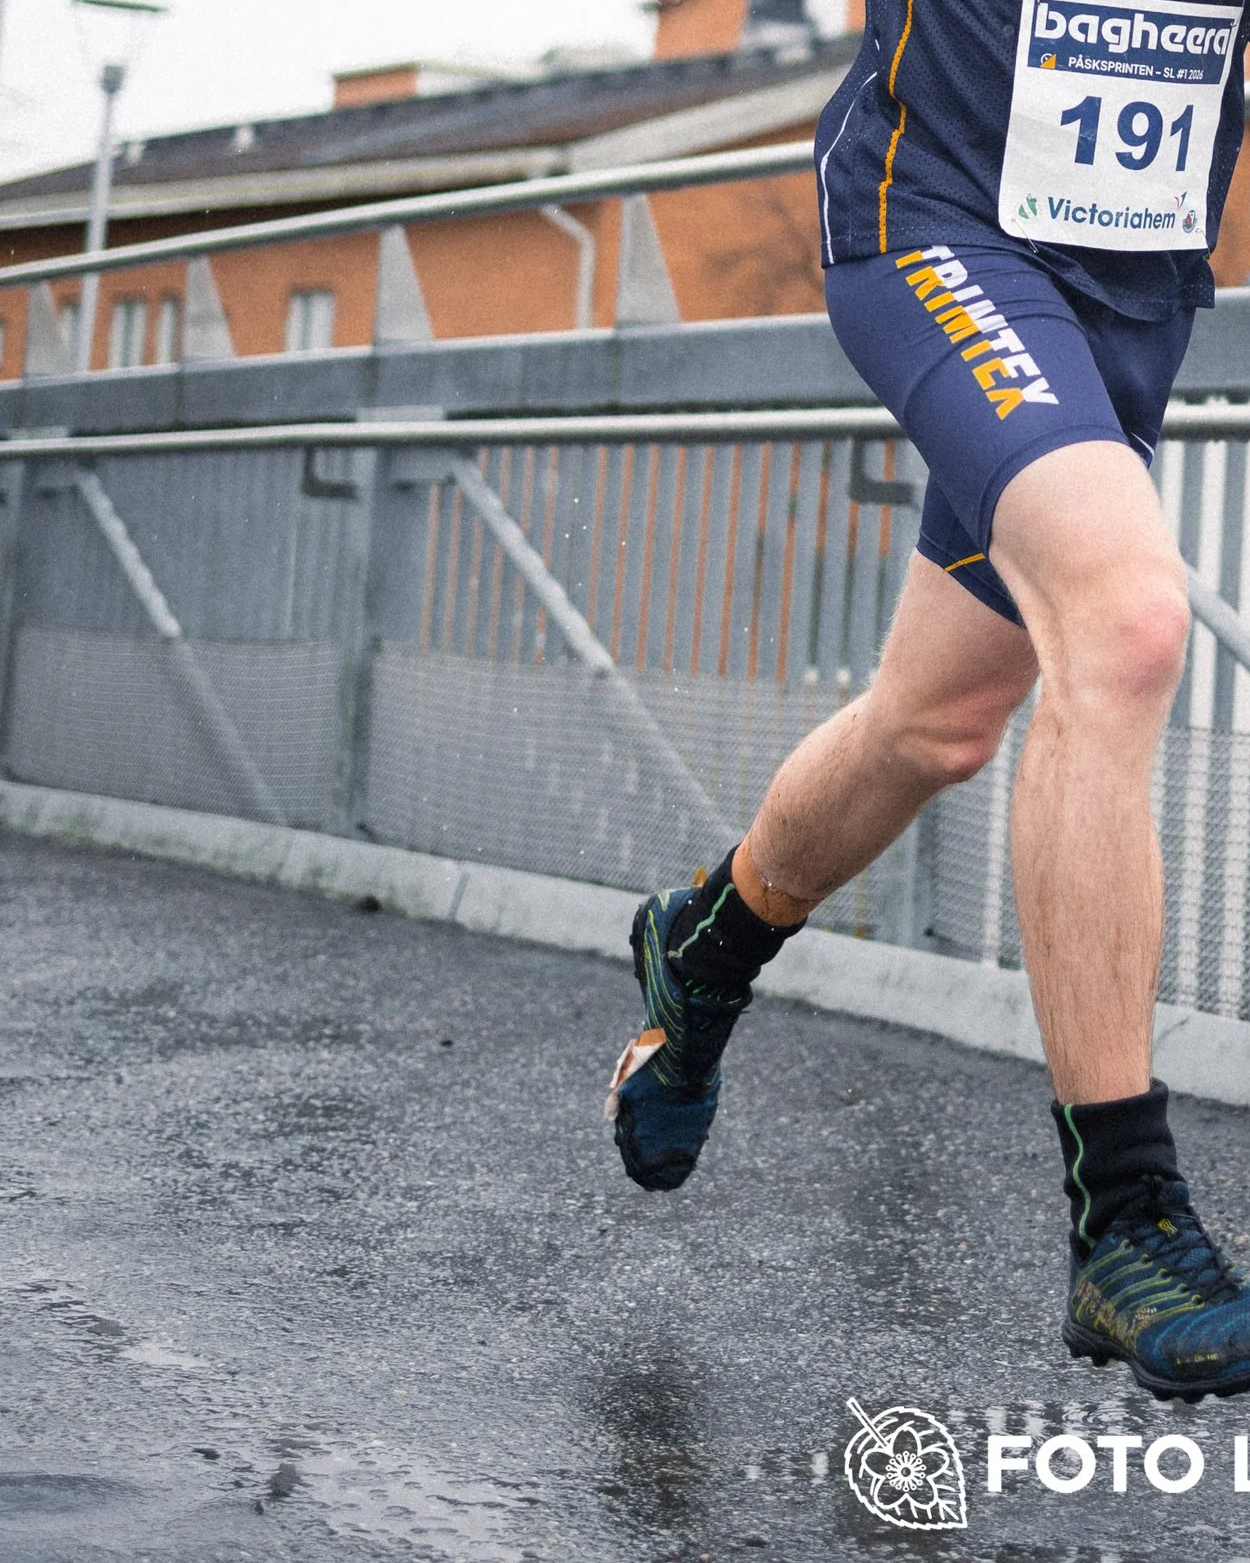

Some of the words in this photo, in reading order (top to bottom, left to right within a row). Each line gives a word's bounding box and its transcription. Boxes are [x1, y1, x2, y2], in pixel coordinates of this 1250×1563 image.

[1034, 2, 1231, 56] bagheera
[1068, 54, 1154, 76] PÅSKSPRINTEN
[1163, 67, 1176, 78] SL
[1060, 95, 1194, 172] 191
[1047, 196, 1176, 229] Victoriahem
[895, 244, 1060, 420] TRIMTEX
